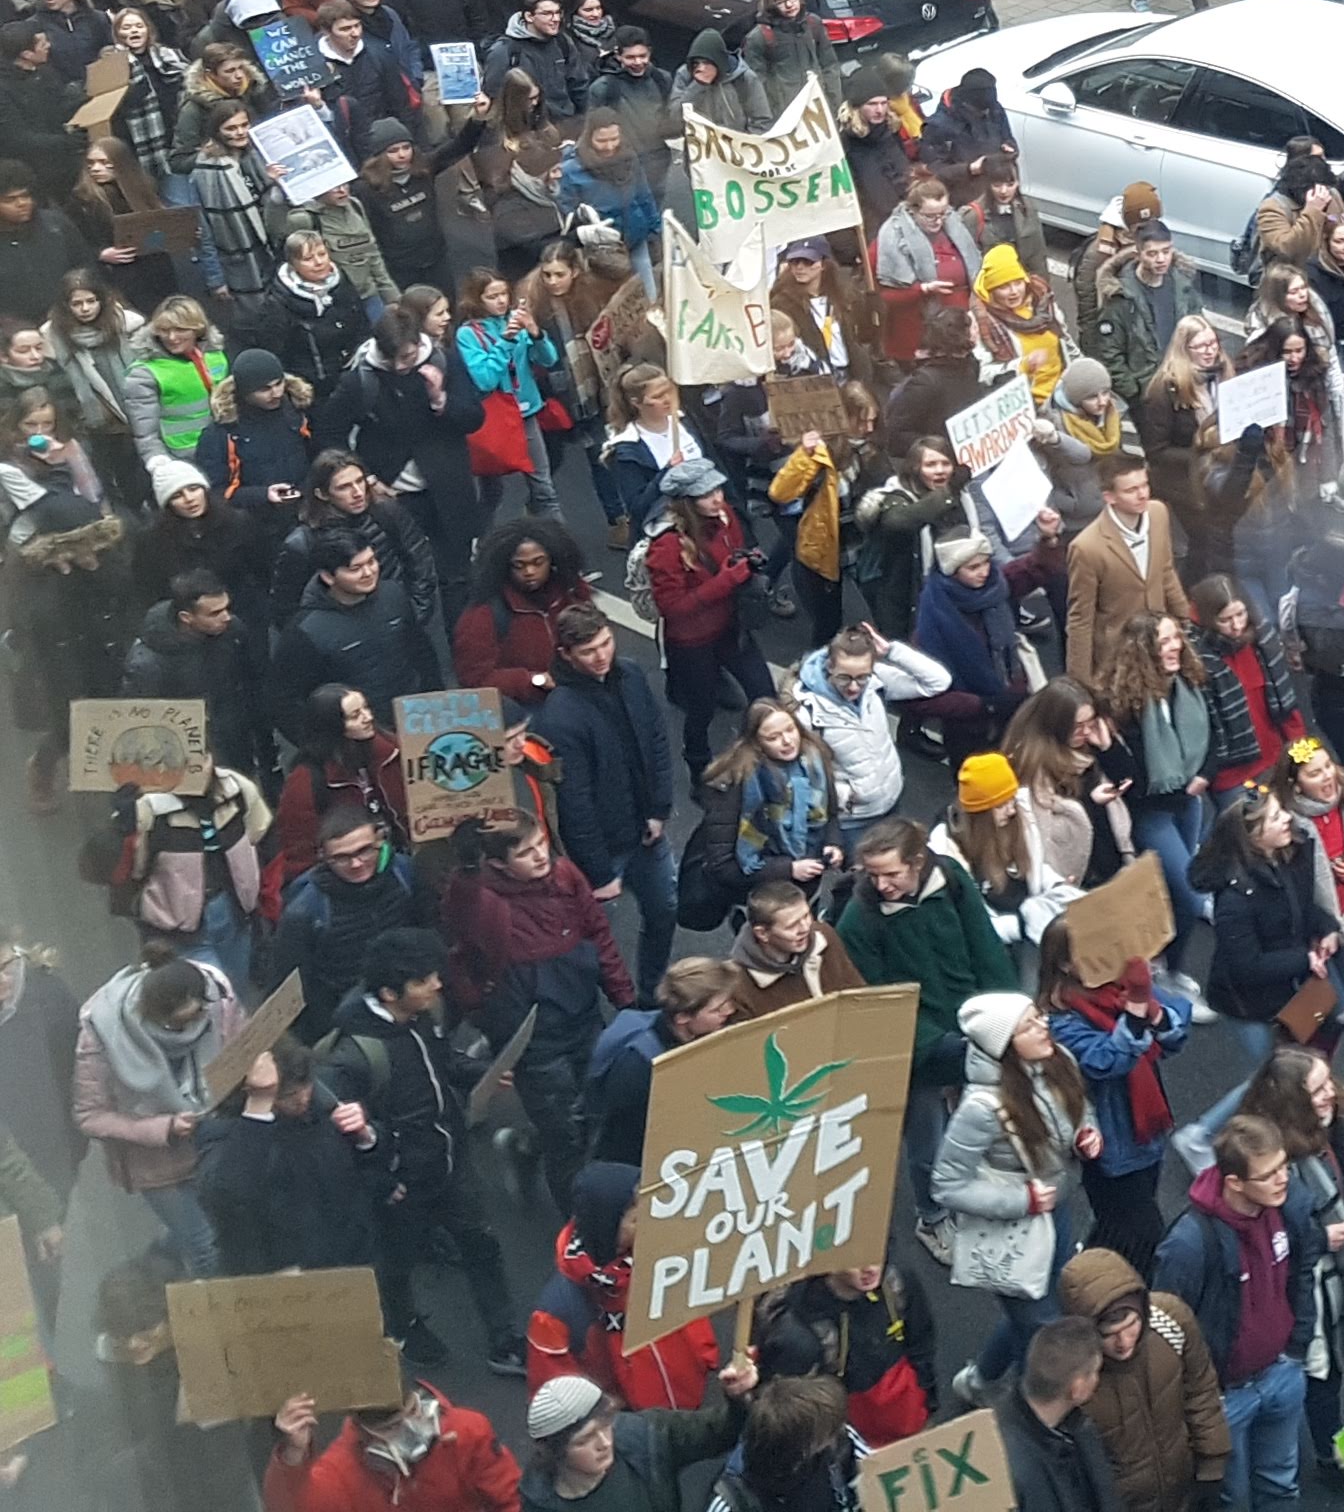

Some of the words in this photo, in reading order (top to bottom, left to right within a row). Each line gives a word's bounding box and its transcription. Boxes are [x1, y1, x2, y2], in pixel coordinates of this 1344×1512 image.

[267, 25, 290, 37] WE
[272, 37, 298, 53] CAN
[281, 73, 322, 91] WORLD
[282, 61, 308, 75] THE
[694, 158, 853, 230] BOSSEN
[128, 706, 151, 719] NO
[162, 707, 204, 755] PLANET
[651, 1093, 868, 1219] SAVE
[705, 1191, 795, 1244] OUR
